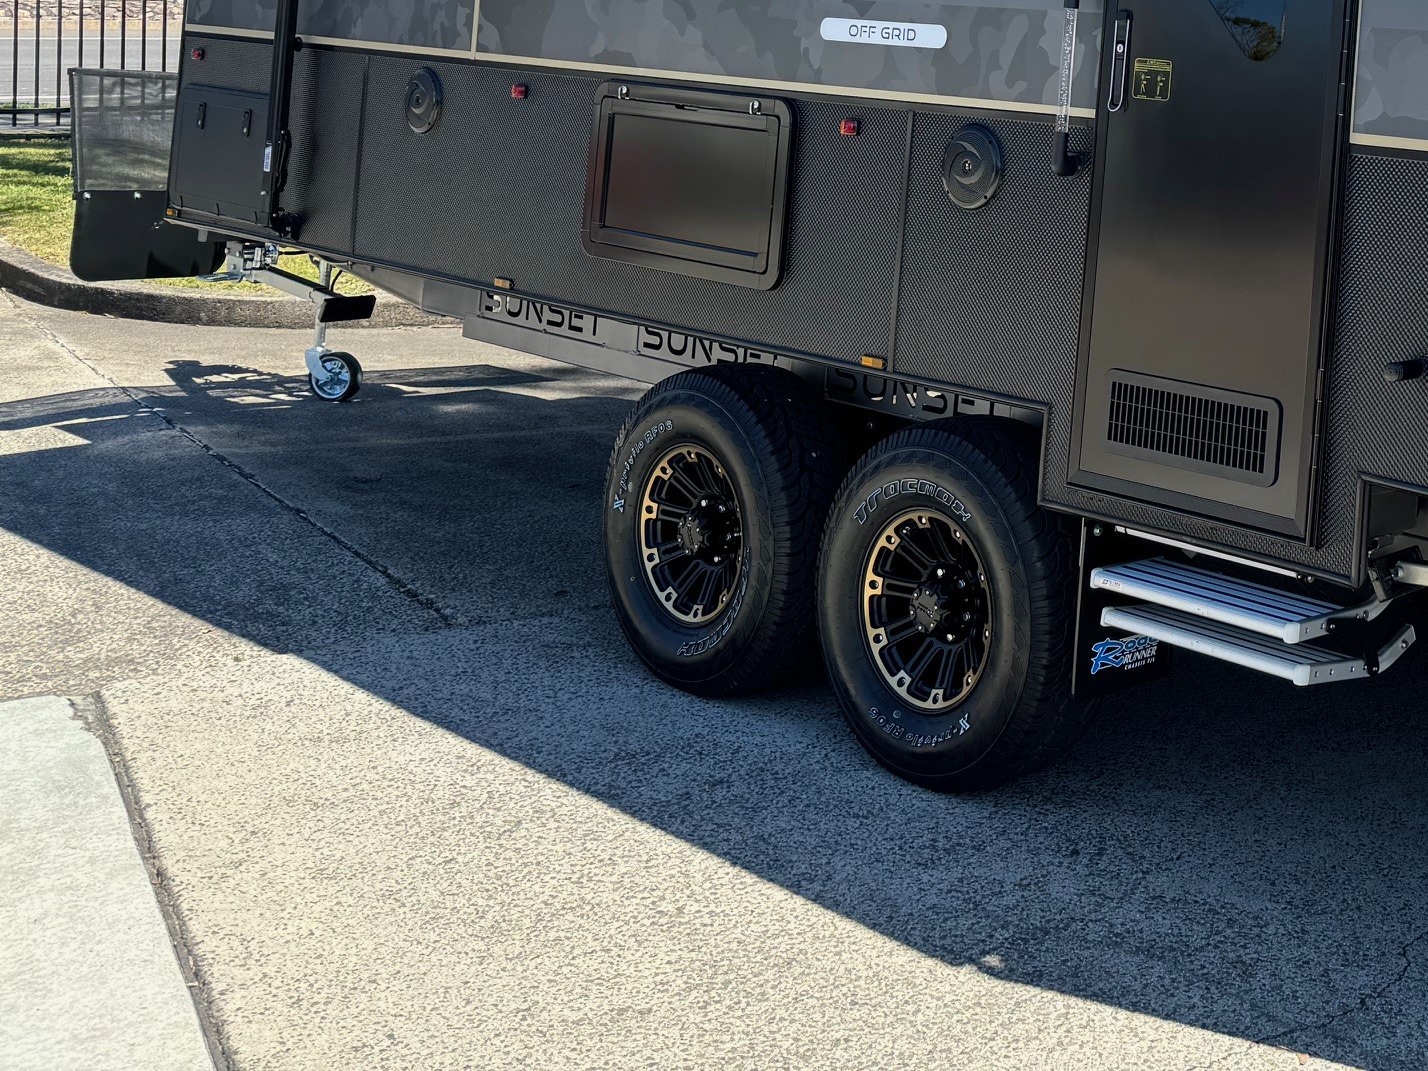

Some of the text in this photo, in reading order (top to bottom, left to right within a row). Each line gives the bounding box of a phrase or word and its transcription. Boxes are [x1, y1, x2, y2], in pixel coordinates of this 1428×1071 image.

[848, 24, 917, 41] OFF GRID
[484, 291, 598, 337] SUNSET
[642, 327, 778, 366] SUNS
[1123, 646, 1158, 665] RUNNER
